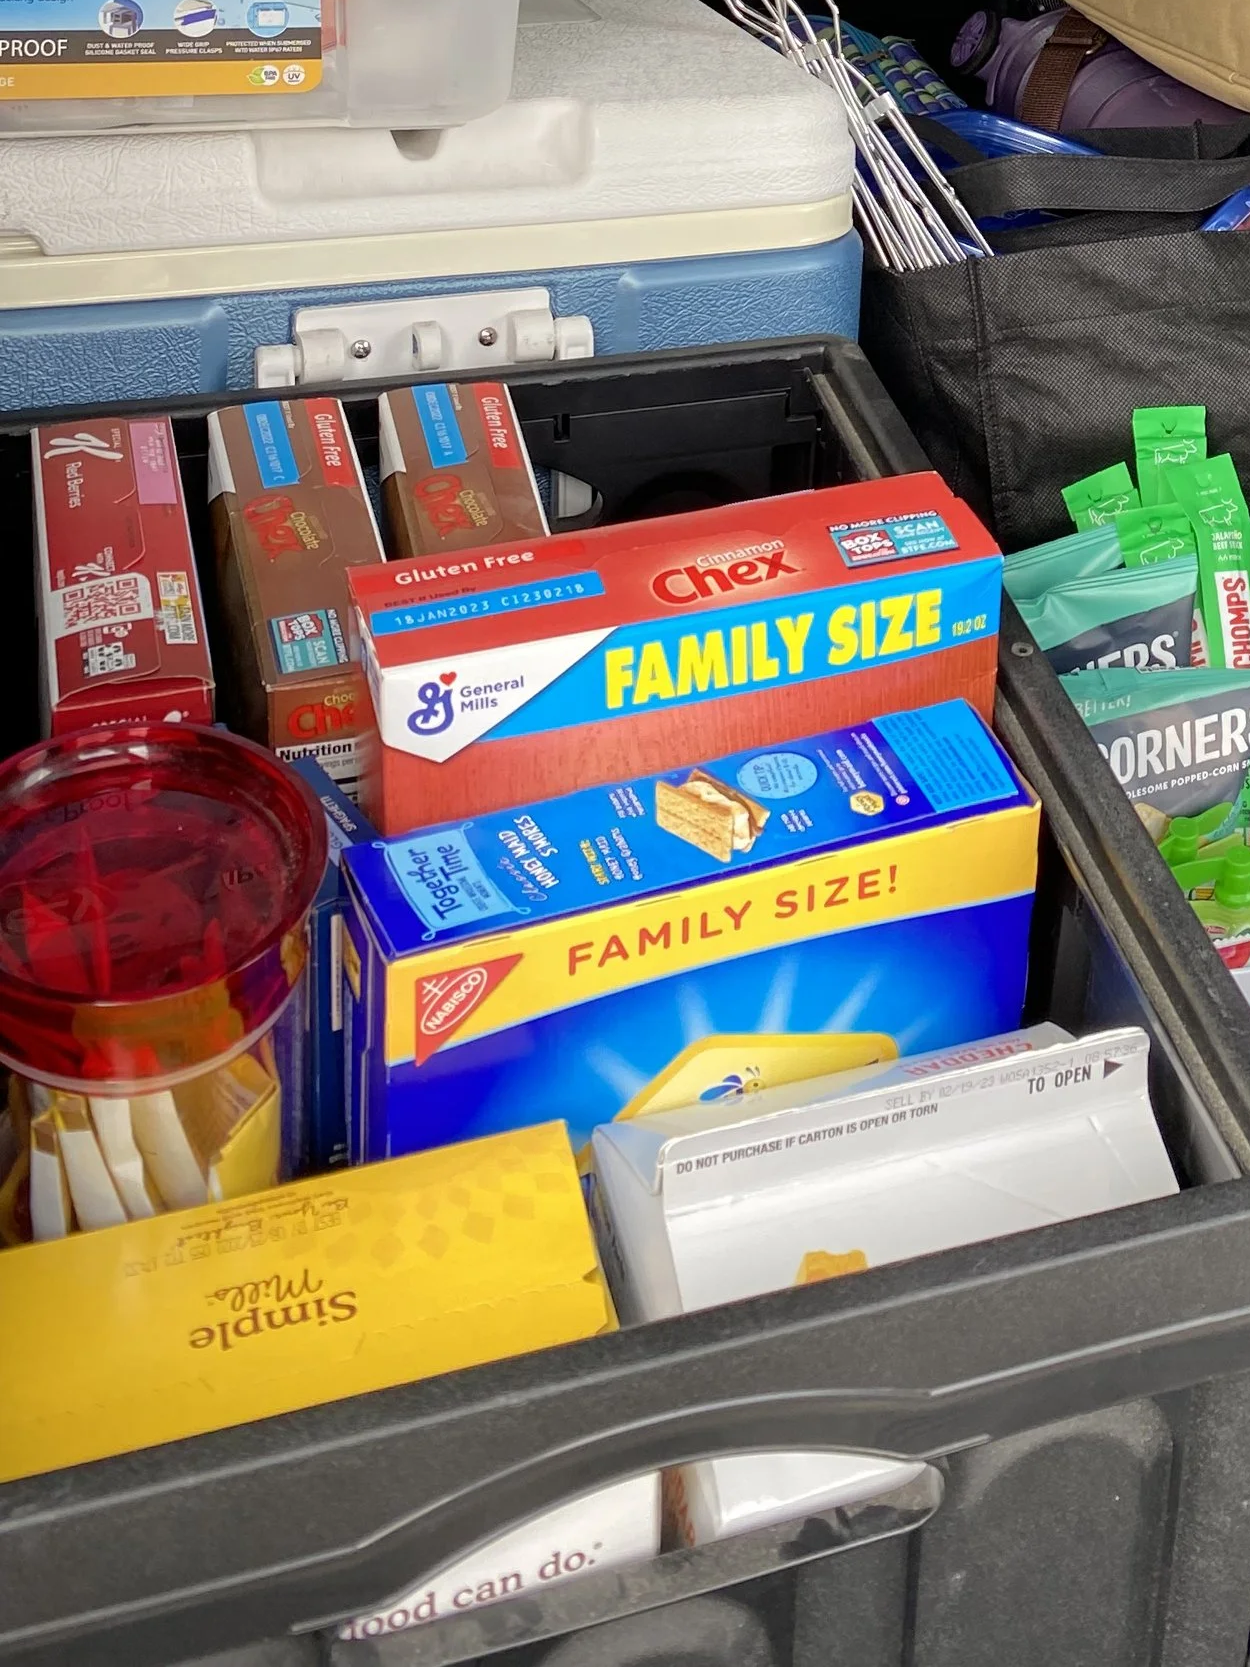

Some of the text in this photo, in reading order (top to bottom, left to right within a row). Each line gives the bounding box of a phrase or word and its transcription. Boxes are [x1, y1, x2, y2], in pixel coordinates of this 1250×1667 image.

[0, 39, 68, 58] PROOF
[288, 73, 300, 81] UV
[314, 413, 342, 467] Gluten Free
[481, 396, 509, 450] Gluten Free
[66, 461, 86, 509] Red Berries
[414, 474, 477, 539] Chex
[460, 489, 488, 527] Chocolate
[829, 509, 938, 532] NO MORE CLIPPING
[243, 494, 305, 560] Chex
[290, 511, 321, 550] Chocolate
[841, 532, 884, 551] BOX
[893, 520, 940, 535] SCAN
[1213, 541, 1228, 550] BEEF
[696, 537, 784, 569] Cinnamon
[851, 538, 894, 555] TOPS
[395, 550, 535, 585] Gluten Free
[652, 548, 801, 608] Chex
[299, 614, 318, 635] BOX
[394, 600, 490, 626] 18JAN2023
[951, 613, 988, 637] 19.2 OZ
[313, 640, 331, 665] SCAN
[605, 588, 943, 711] FAMILY SIZE
[460, 675, 525, 698] General
[460, 696, 499, 713] Mills
[279, 742, 352, 762] Nutrition
[1171, 763, 1240, 789] POPPED-CORN
[322, 795, 358, 833] SPAGHETTI
[437, 843, 469, 882] Time
[498, 829, 561, 889] HONEY MAID
[595, 835, 625, 882] HONEY MAID
[407, 847, 465, 921] Together
[569, 864, 898, 976] FAMILY SIZE!
[427, 972, 482, 1032] NABISCO
[904, 1041, 1034, 1077] CHEDDAR
[1028, 1065, 1092, 1095] TO OPEN
[885, 1093, 915, 1111] SELL
[676, 1102, 939, 1176] DO NOT PURCHASE IF CARTON IS OPEN OR TORN
[205, 1268, 323, 1313] Mills
[189, 1290, 358, 1352] Simple
[453, 1549, 597, 1612] can do.
